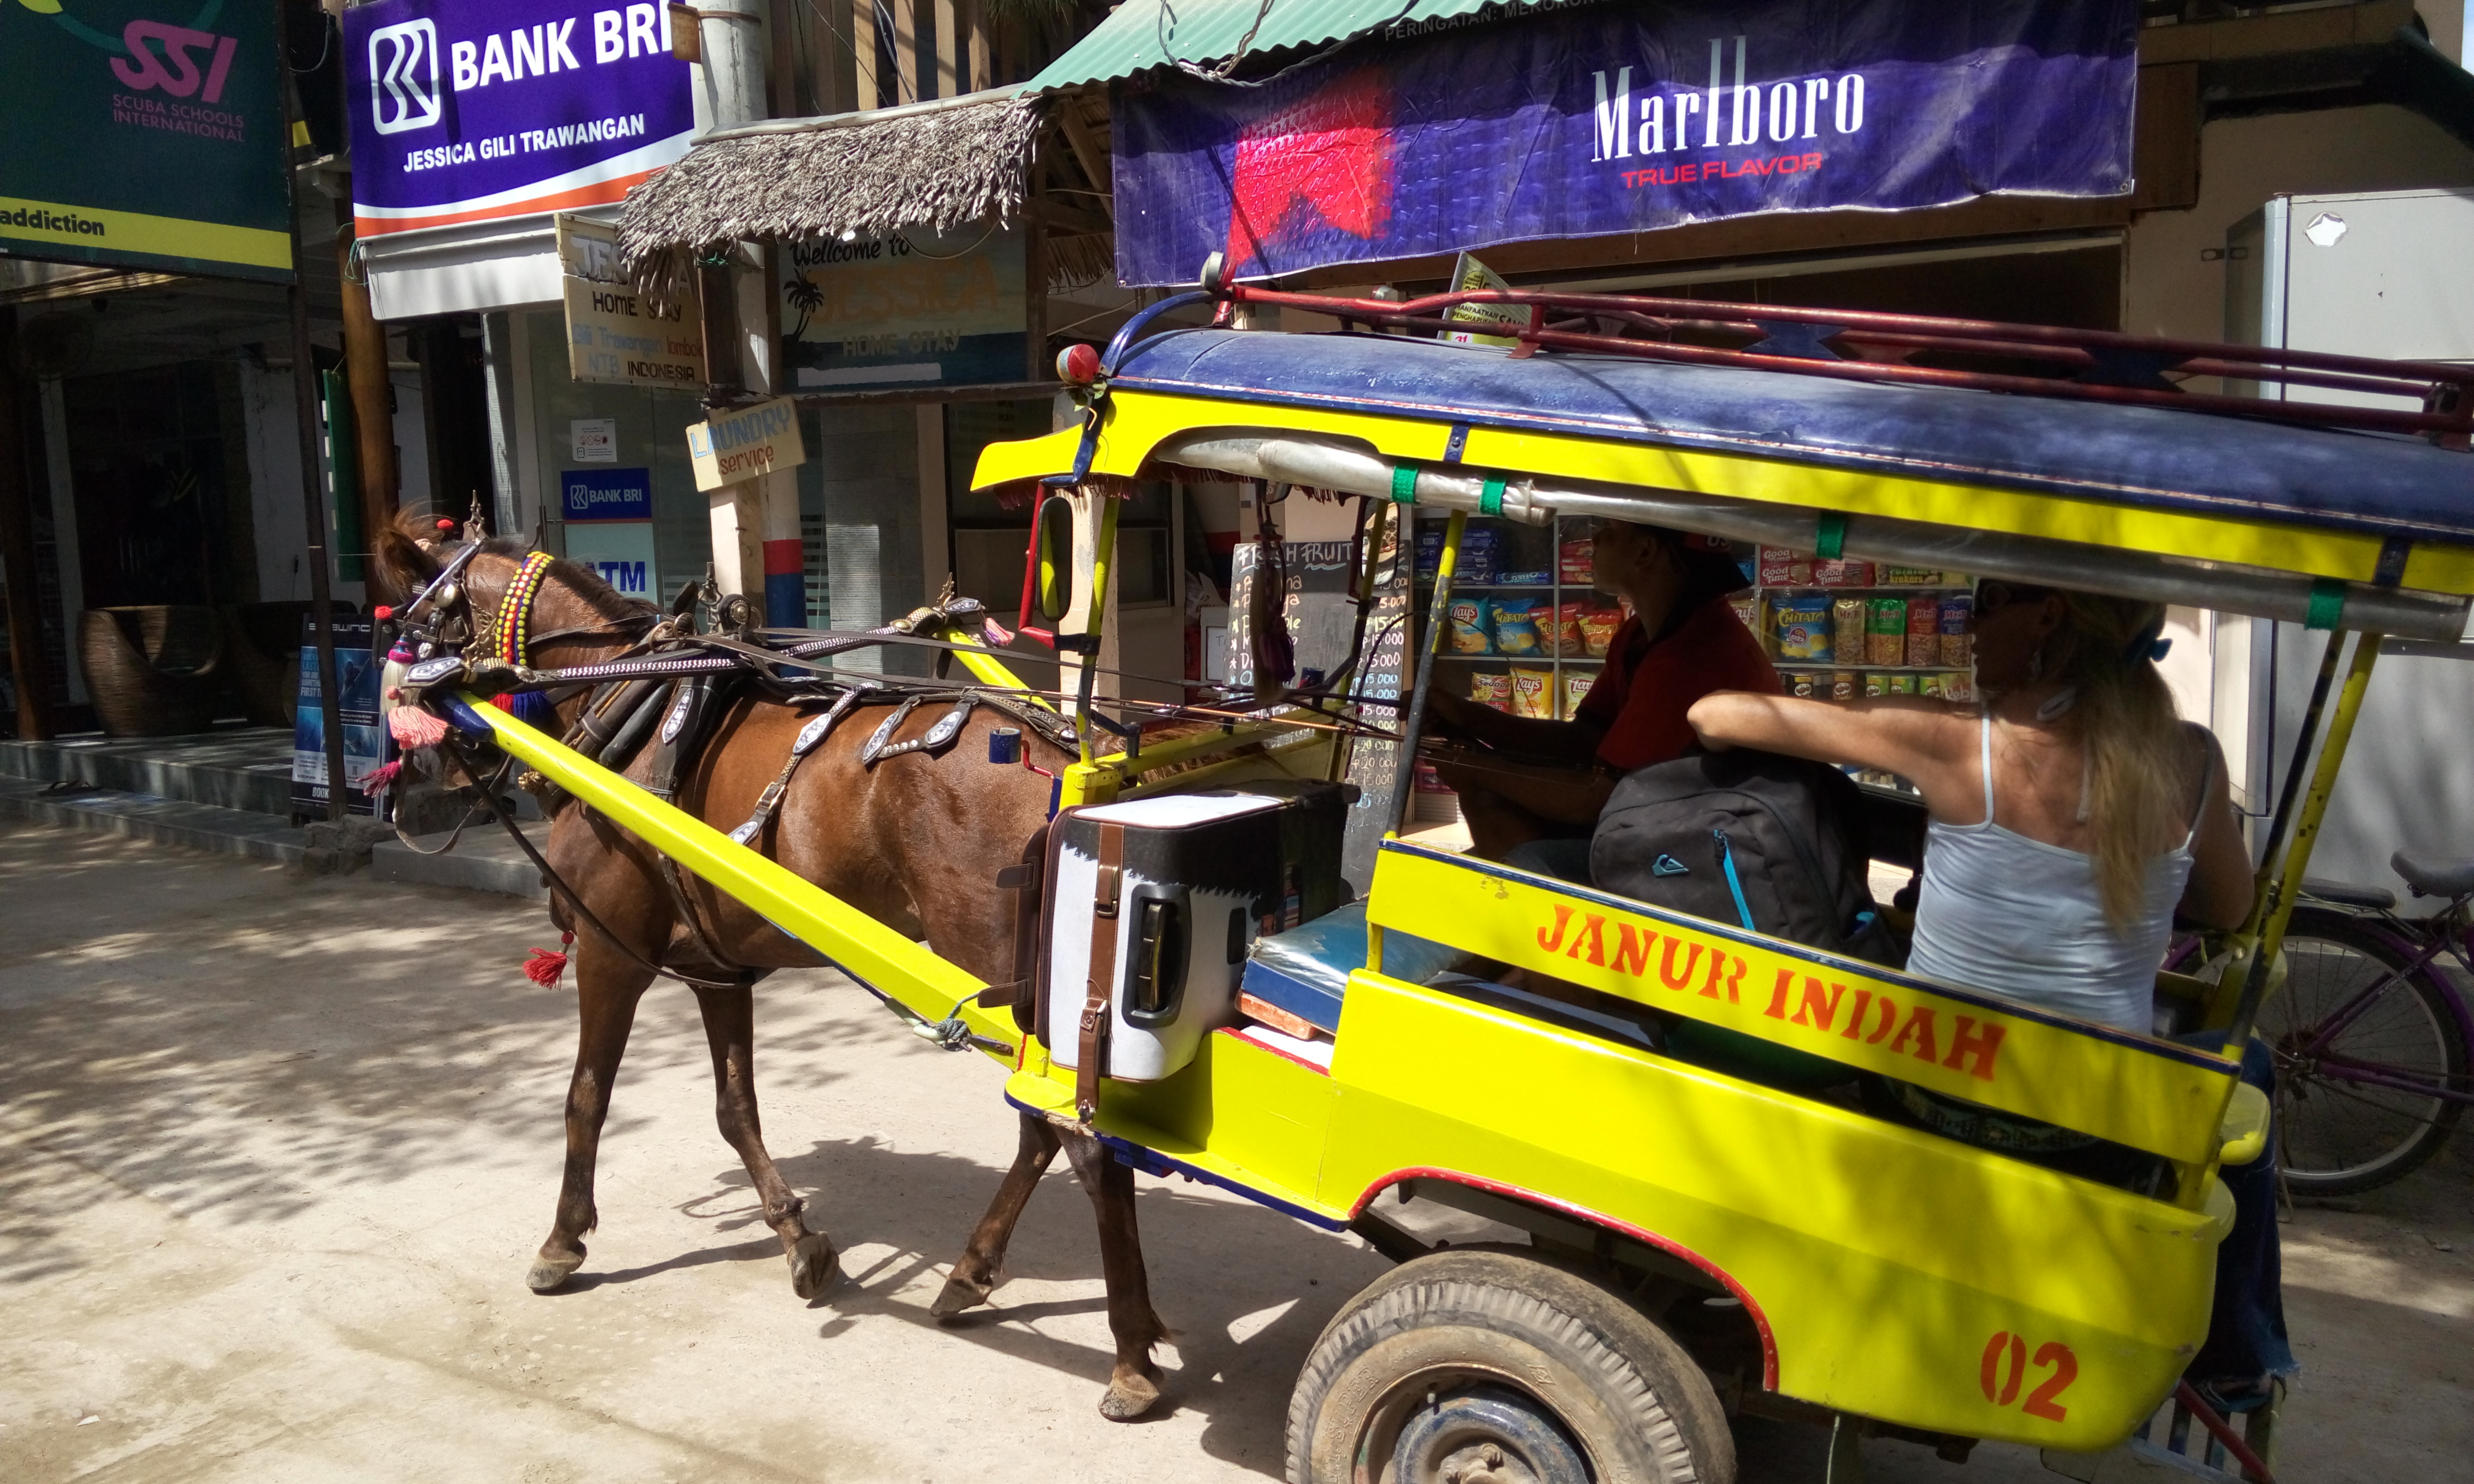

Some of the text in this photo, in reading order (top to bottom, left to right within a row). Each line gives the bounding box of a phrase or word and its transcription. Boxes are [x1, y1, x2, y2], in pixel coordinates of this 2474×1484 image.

[109, 19, 238, 104] SSI
[451, 18, 580, 92] BANK
[113, 93, 244, 128] SCUBA SCHOOLS
[1591, 34, 1865, 162] Marlboro
[113, 109, 245, 142] INTERNATIONAL
[403, 113, 645, 172] JESSICA GILI TRAWANGAN
[1620, 152, 1822, 189] TRUE FLAVOR
[0, 208, 105, 236] addiction
[789, 239, 882, 267] Wellcome
[805, 255, 1000, 325] JESSICA
[843, 333, 900, 357] HOME
[627, 361, 695, 381] INDONESIA
[690, 403, 791, 459] LAUNDRY
[589, 488, 643, 504] BANK BRI
[1762, 566, 1789, 577] Good
[1763, 549, 1790, 559] Good
[1766, 573, 1789, 584] Time
[1537, 903, 2007, 1082] JANUR INDAH
[1980, 1331, 2079, 1423] 02
